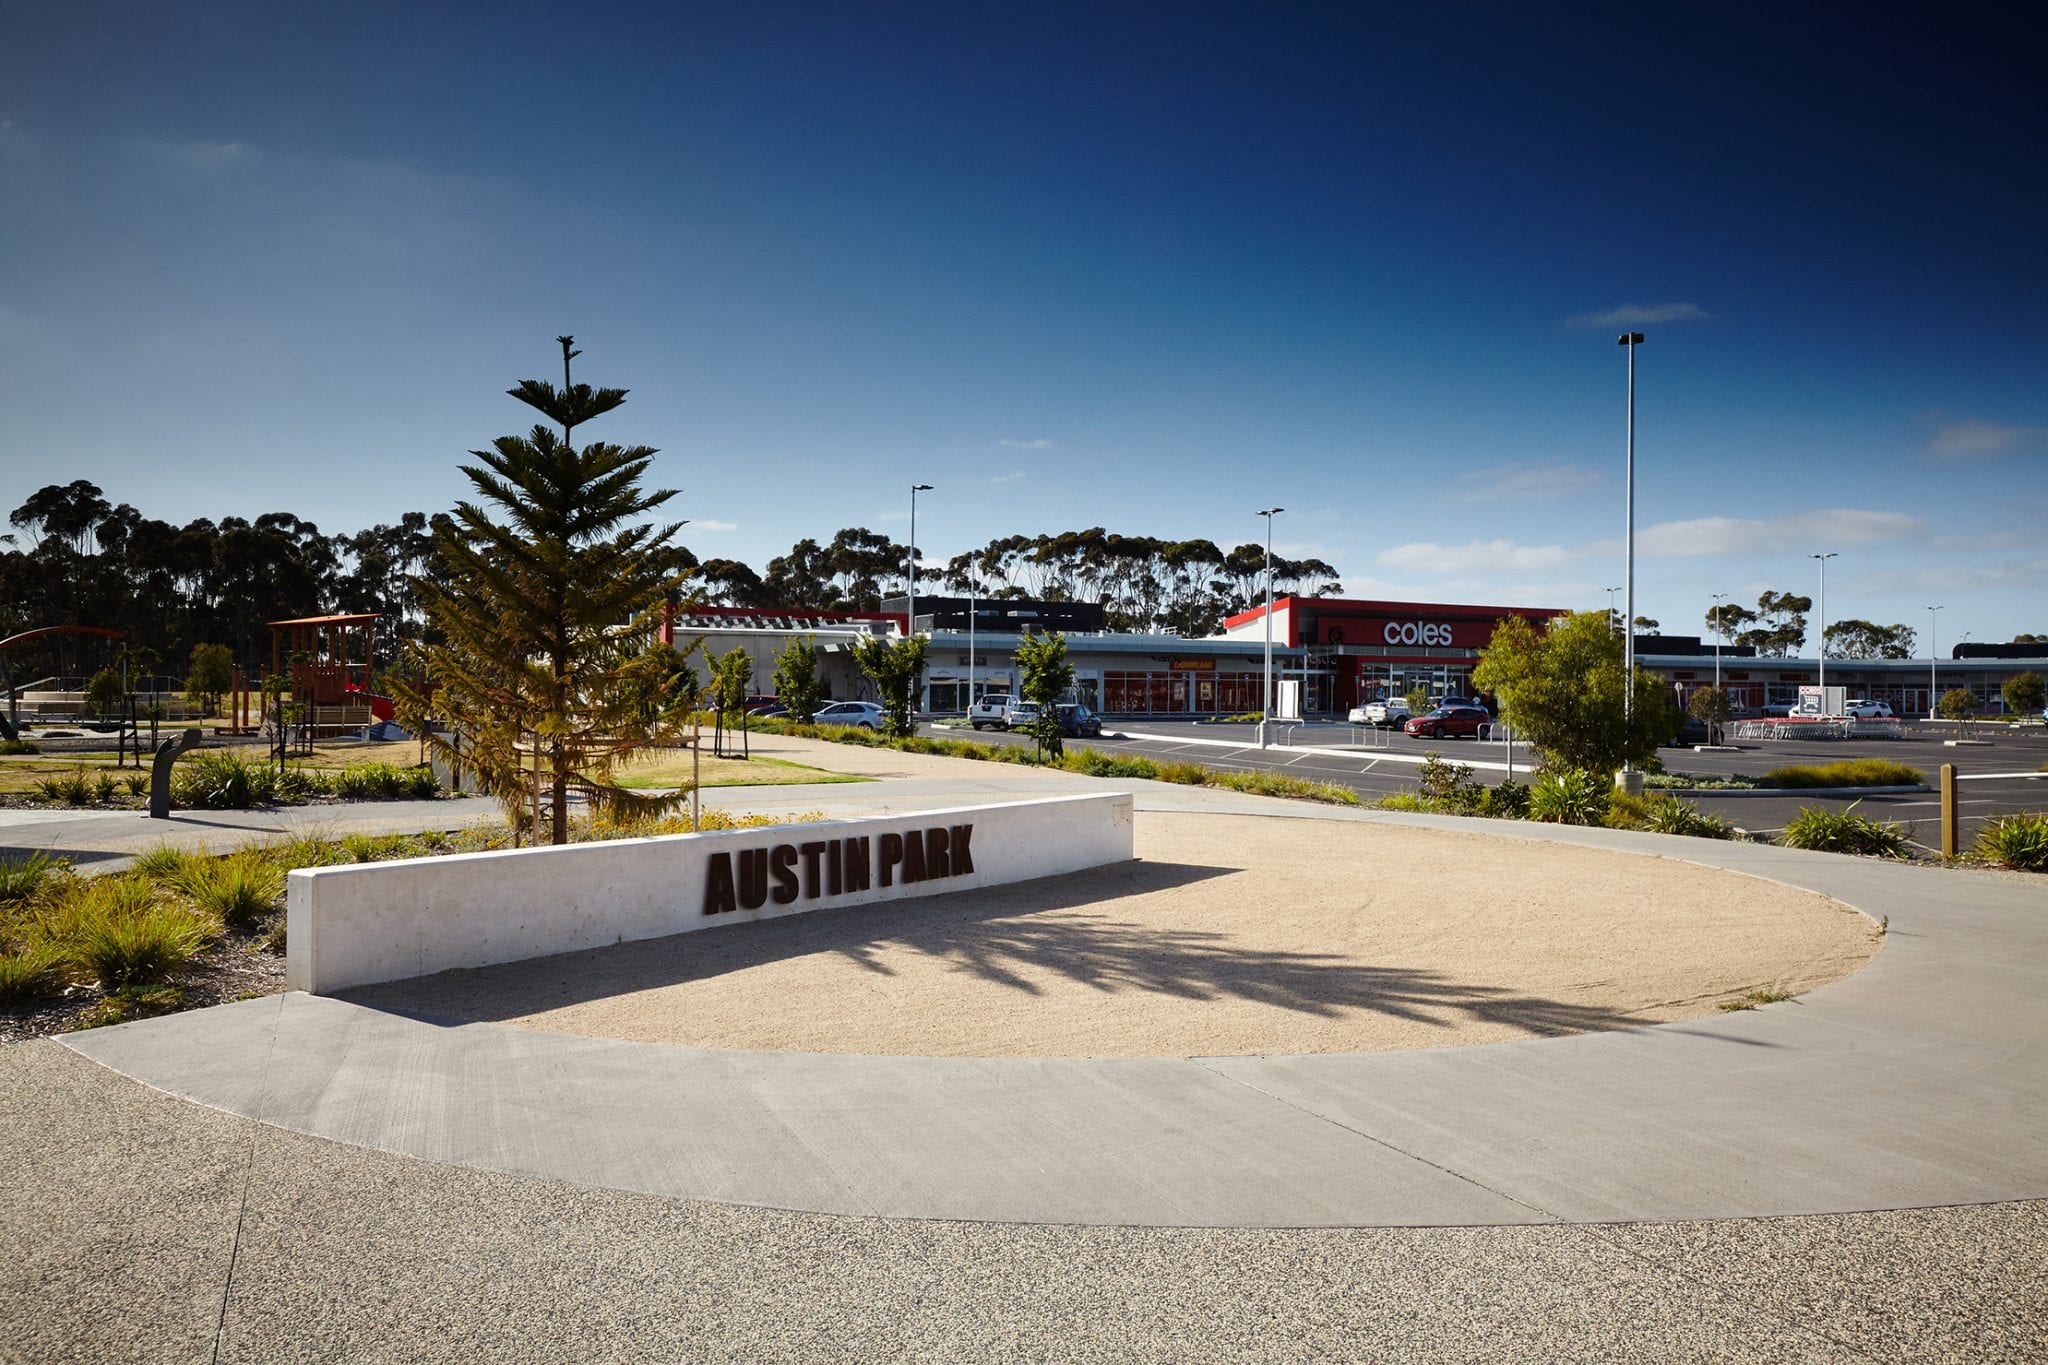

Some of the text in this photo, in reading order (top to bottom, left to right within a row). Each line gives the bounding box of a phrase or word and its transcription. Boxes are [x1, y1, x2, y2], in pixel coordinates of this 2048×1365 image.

[1384, 621, 1453, 646] coles
[705, 824, 974, 915] AUSTIN PARK
